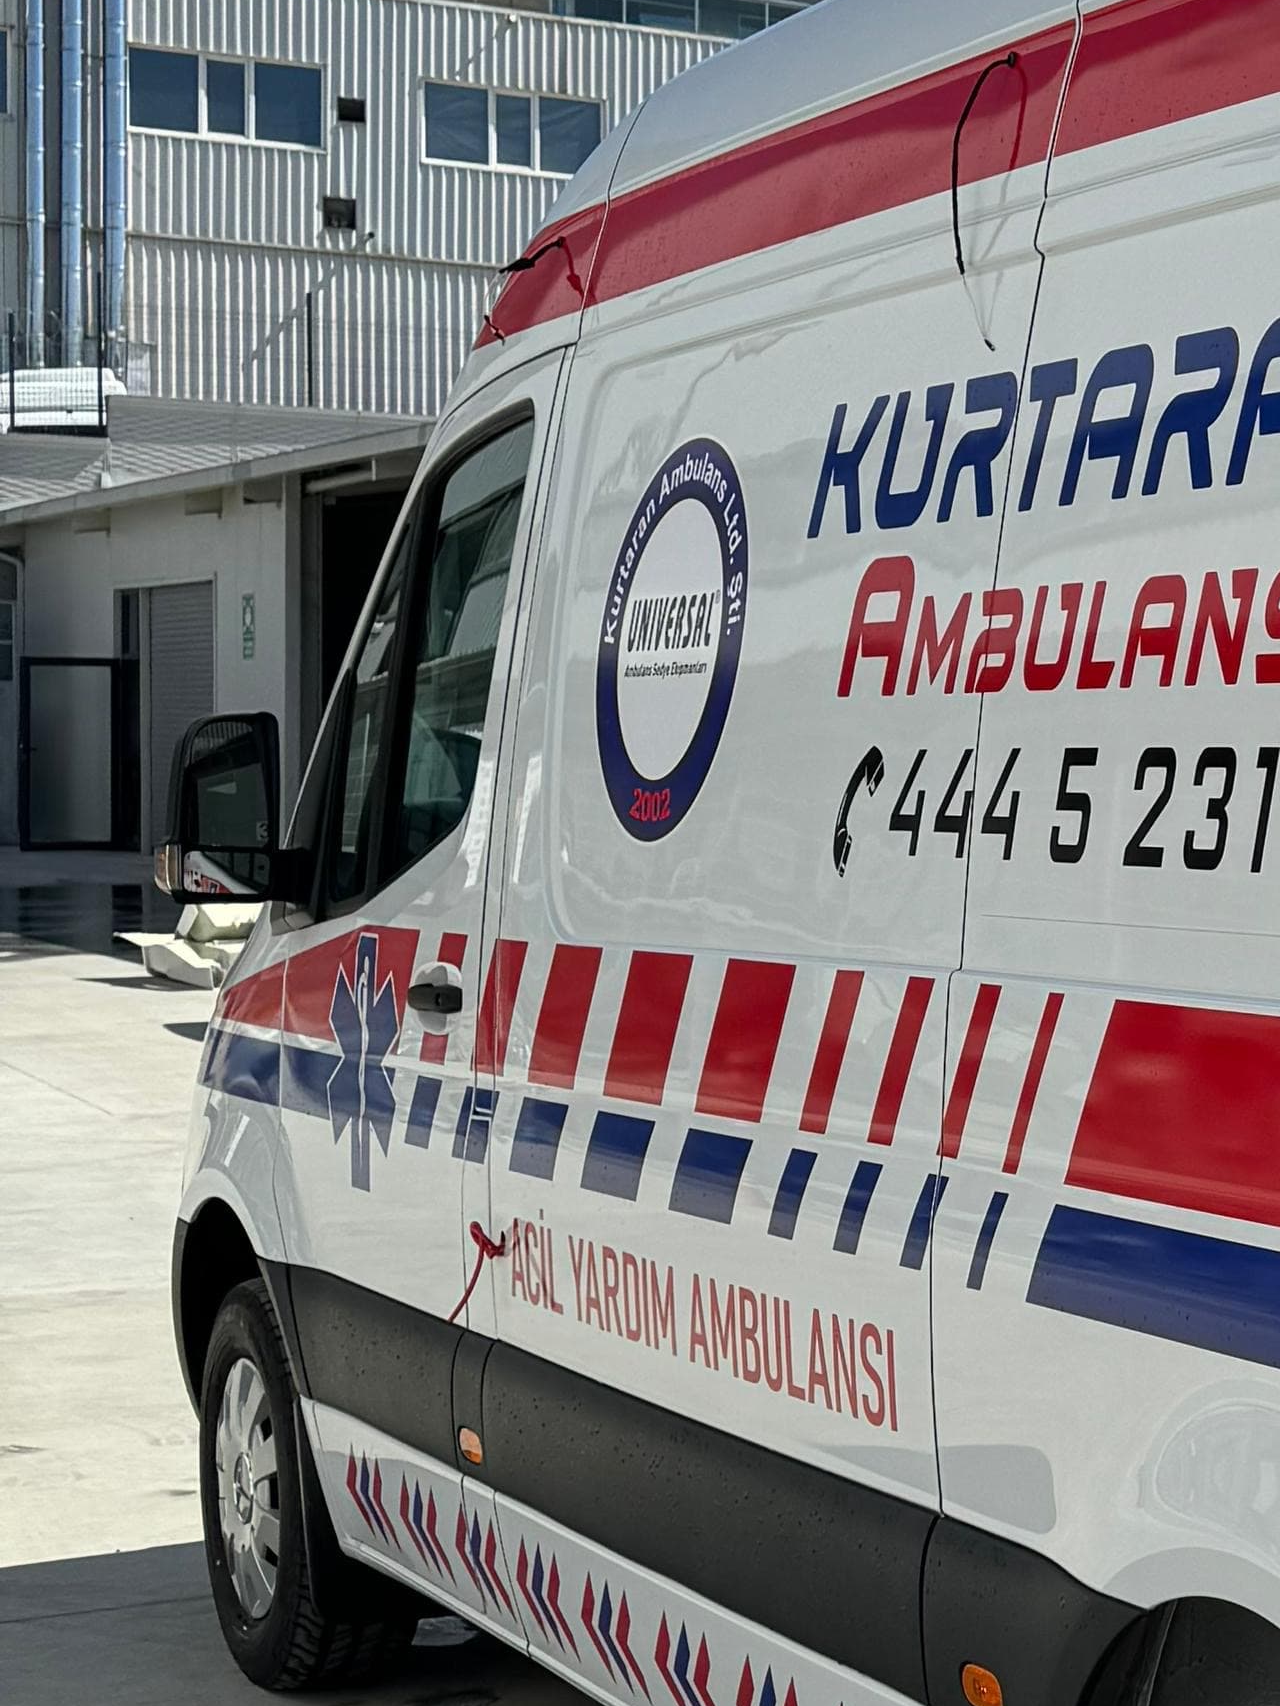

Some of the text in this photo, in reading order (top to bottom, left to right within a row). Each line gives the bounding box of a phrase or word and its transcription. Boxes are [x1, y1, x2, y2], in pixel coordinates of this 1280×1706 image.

[604, 498, 657, 644] Kurtaran
[659, 452, 728, 505] Ambulans
[723, 493, 743, 566] Ltd.
[627, 591, 715, 653] UNIVERSAL
[629, 787, 671, 822] 2002
[888, 746, 1280, 874] 444 5 231
[511, 1208, 899, 1433] ACİL YARDIM AMBULANSI
